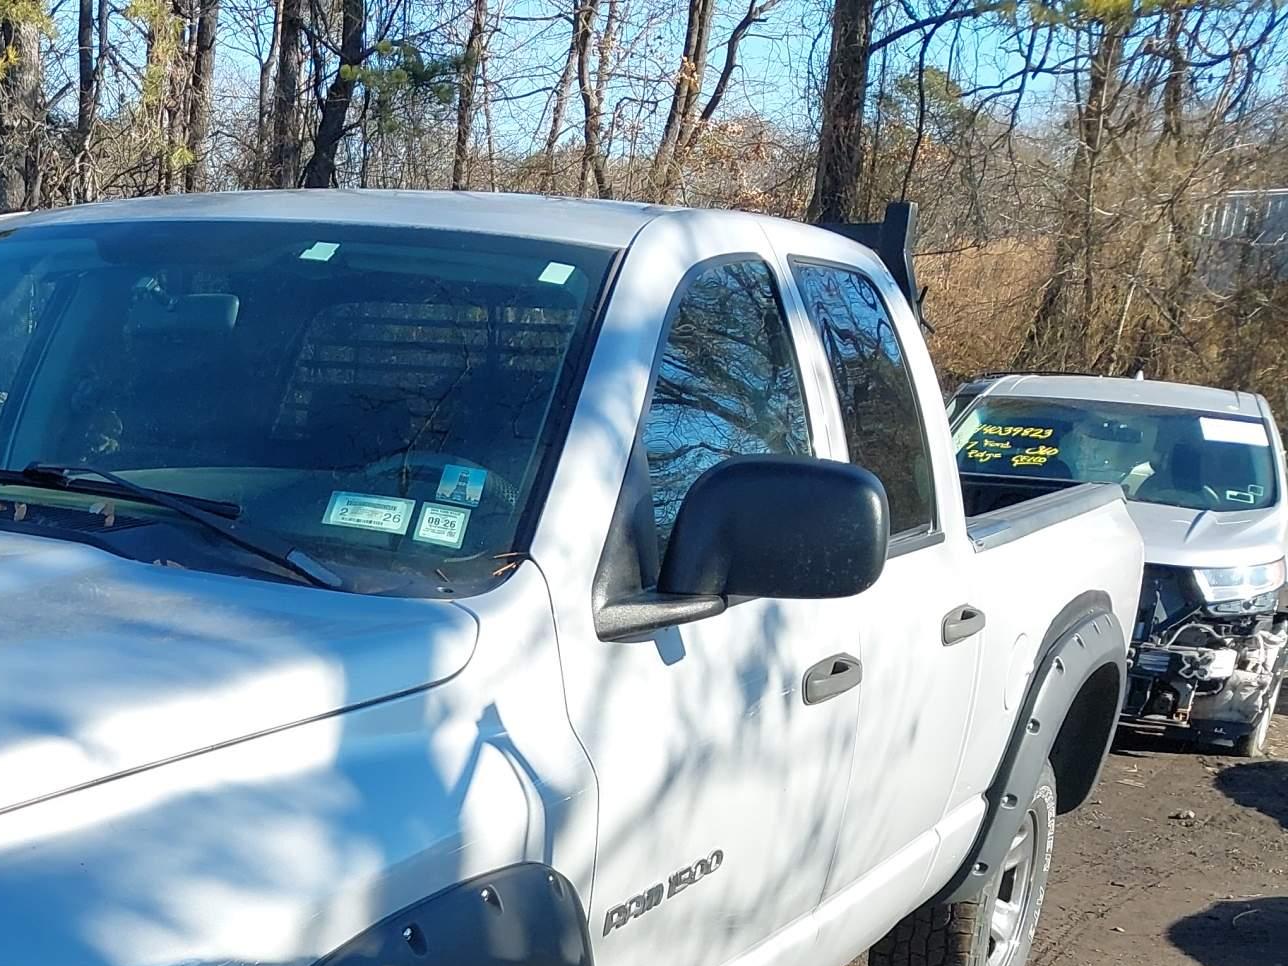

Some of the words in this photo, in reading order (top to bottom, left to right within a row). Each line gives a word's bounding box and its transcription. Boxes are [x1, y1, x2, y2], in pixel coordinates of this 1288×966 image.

[382, 513, 401, 524] 26
[602, 883, 664, 937] RAM
[666, 848, 724, 899] 1500
